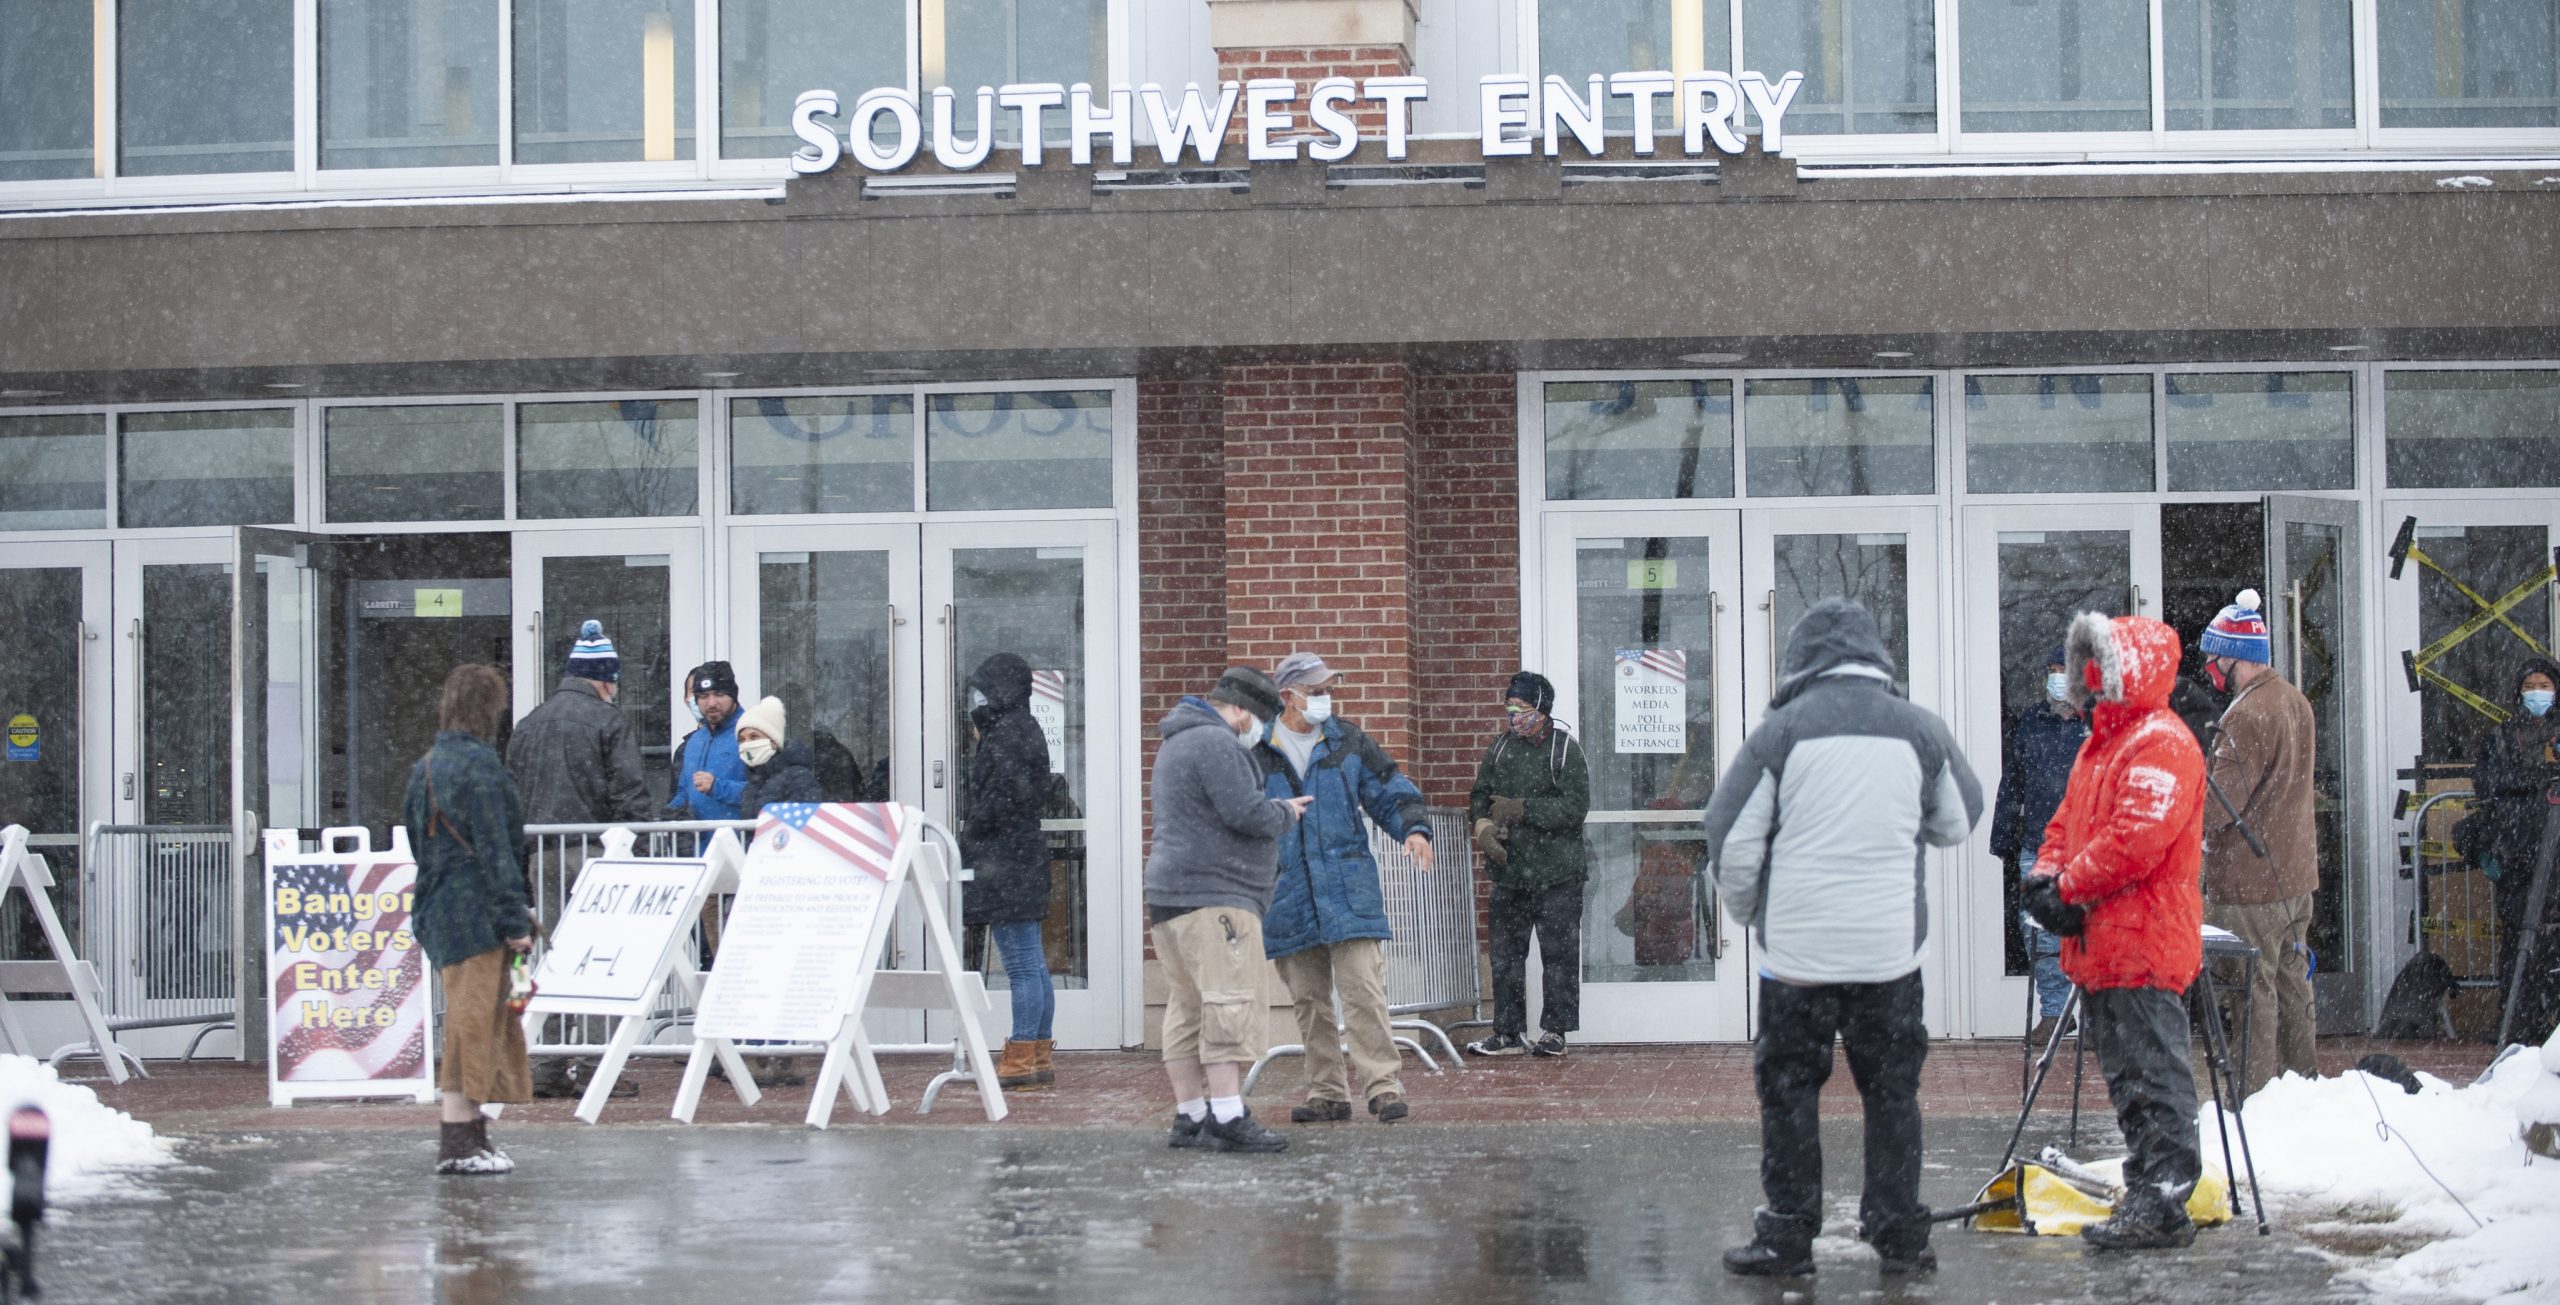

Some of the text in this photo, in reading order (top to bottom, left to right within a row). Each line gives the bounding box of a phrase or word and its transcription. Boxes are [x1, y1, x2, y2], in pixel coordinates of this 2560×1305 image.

[791, 71, 1804, 173] SOUTHWEST ENTRY
[1648, 567, 1657, 582] 5
[365, 601, 399, 609] GARRETT
[434, 593, 443, 607] 4
[1623, 685, 1678, 694] WORKERS
[1035, 704, 1050, 713] TO
[1632, 700, 1669, 709] MEDIA
[1637, 714, 1665, 724] POLL
[1620, 723, 1681, 733] WATCHERS
[1621, 738, 1681, 748] ENTRANCE
[759, 875, 869, 886] REGISTERING TO VOTE?
[276, 887, 415, 920] Bangor
[578, 883, 685, 916] LAST NAME
[281, 925, 412, 952] Voters
[295, 962, 402, 990] Enter
[302, 1000, 397, 1028] Here
